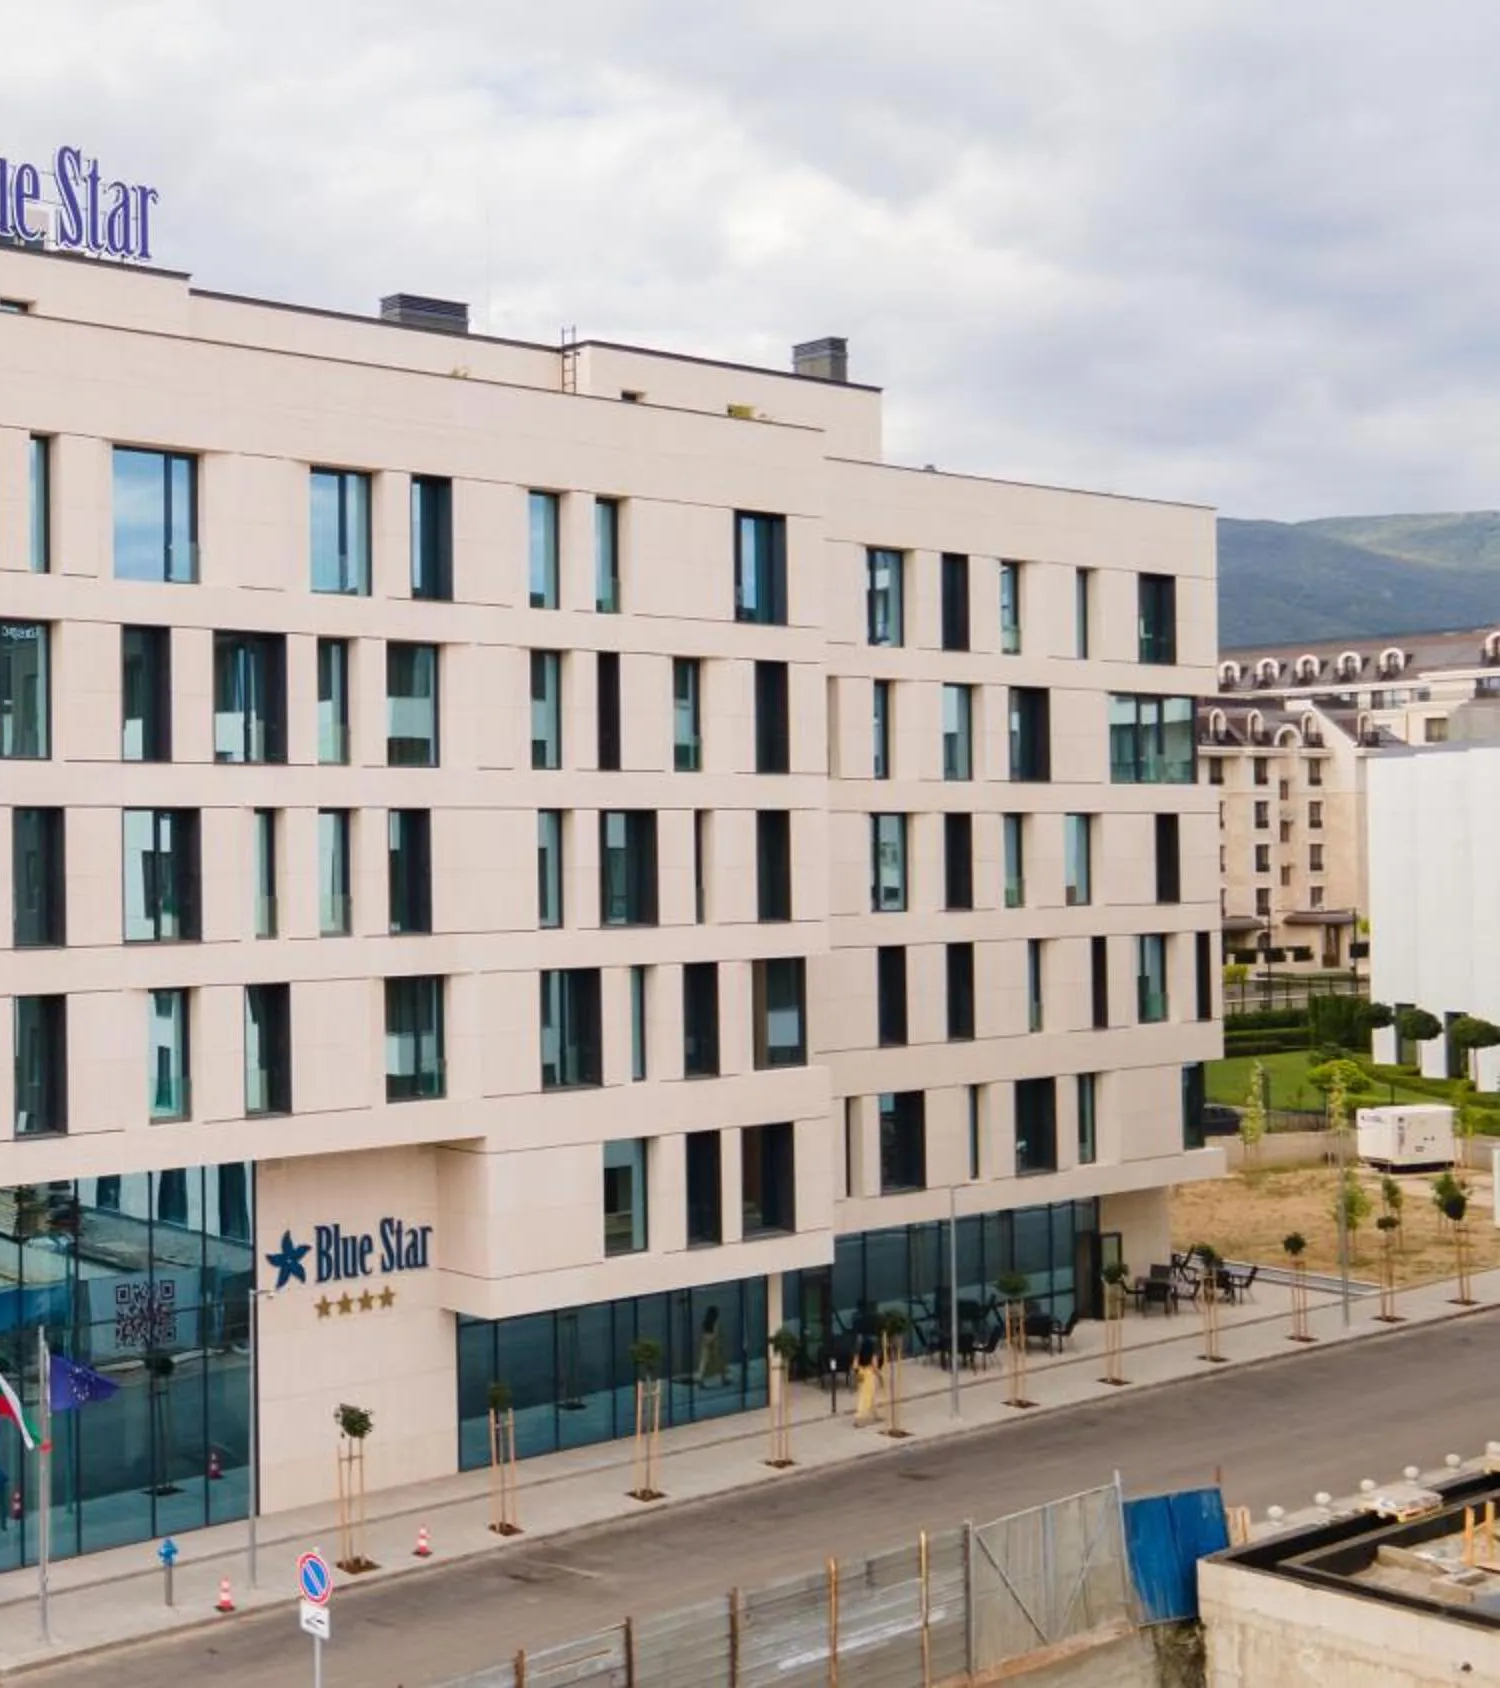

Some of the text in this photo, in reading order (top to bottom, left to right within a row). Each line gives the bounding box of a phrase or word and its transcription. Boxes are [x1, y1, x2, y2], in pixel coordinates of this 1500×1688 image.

[54, 145, 158, 260] Star
[314, 1216, 433, 1283] Blue Star
